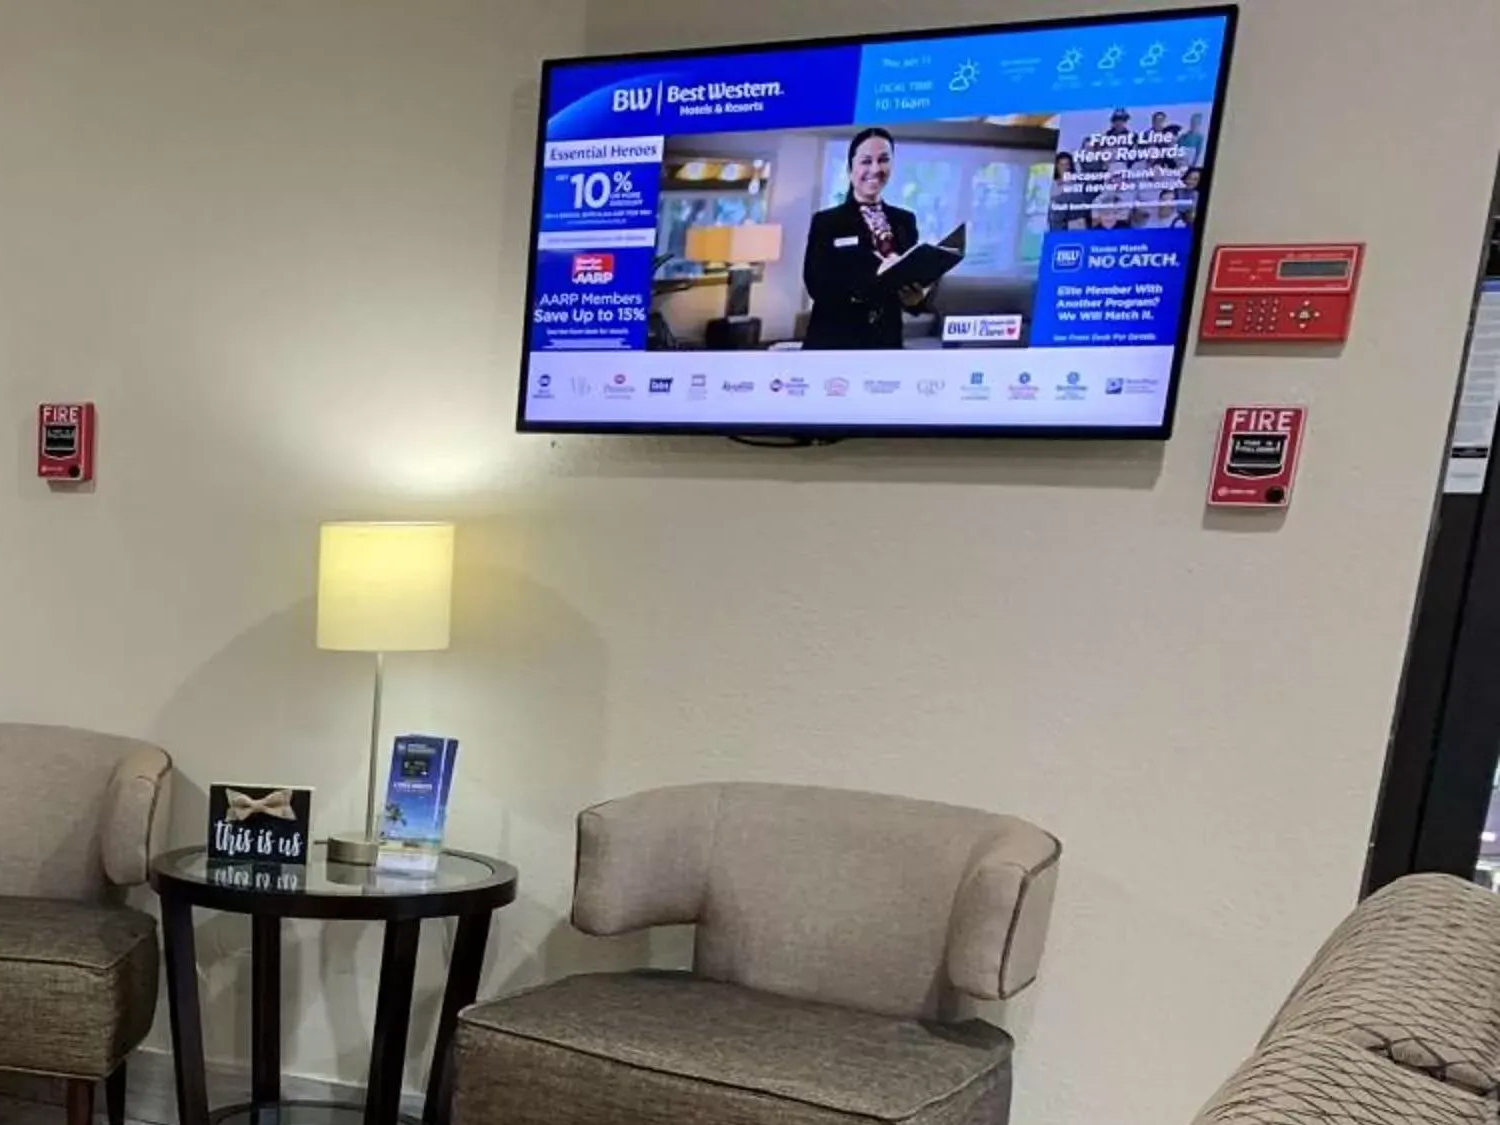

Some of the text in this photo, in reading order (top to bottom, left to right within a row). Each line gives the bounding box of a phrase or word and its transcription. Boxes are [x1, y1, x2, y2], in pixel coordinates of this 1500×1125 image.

[612, 87, 652, 112] BW
[667, 84, 706, 103] Best
[679, 101, 764, 116] Hotels & Resorts
[1090, 130, 1173, 147] Front Line
[550, 144, 657, 161] Essential Heroes
[1073, 144, 1187, 163] Hero Rewards
[1063, 171, 1111, 182] Because
[1085, 182, 1119, 193] never
[1088, 254, 1116, 269] NO
[572, 272, 614, 284] AARP
[1056, 283, 1164, 297] Elite Member With
[540, 291, 643, 306] AARP Members
[1056, 296, 1161, 309] Another Program?
[534, 307, 647, 325] Save Up to 15%
[1057, 311, 1077, 321] We
[1080, 310, 1103, 321] Will
[1104, 310, 1139, 321] Match
[42, 406, 80, 424] FIRE
[1231, 410, 1296, 431] FIRE
[214, 819, 304, 857] this is us
